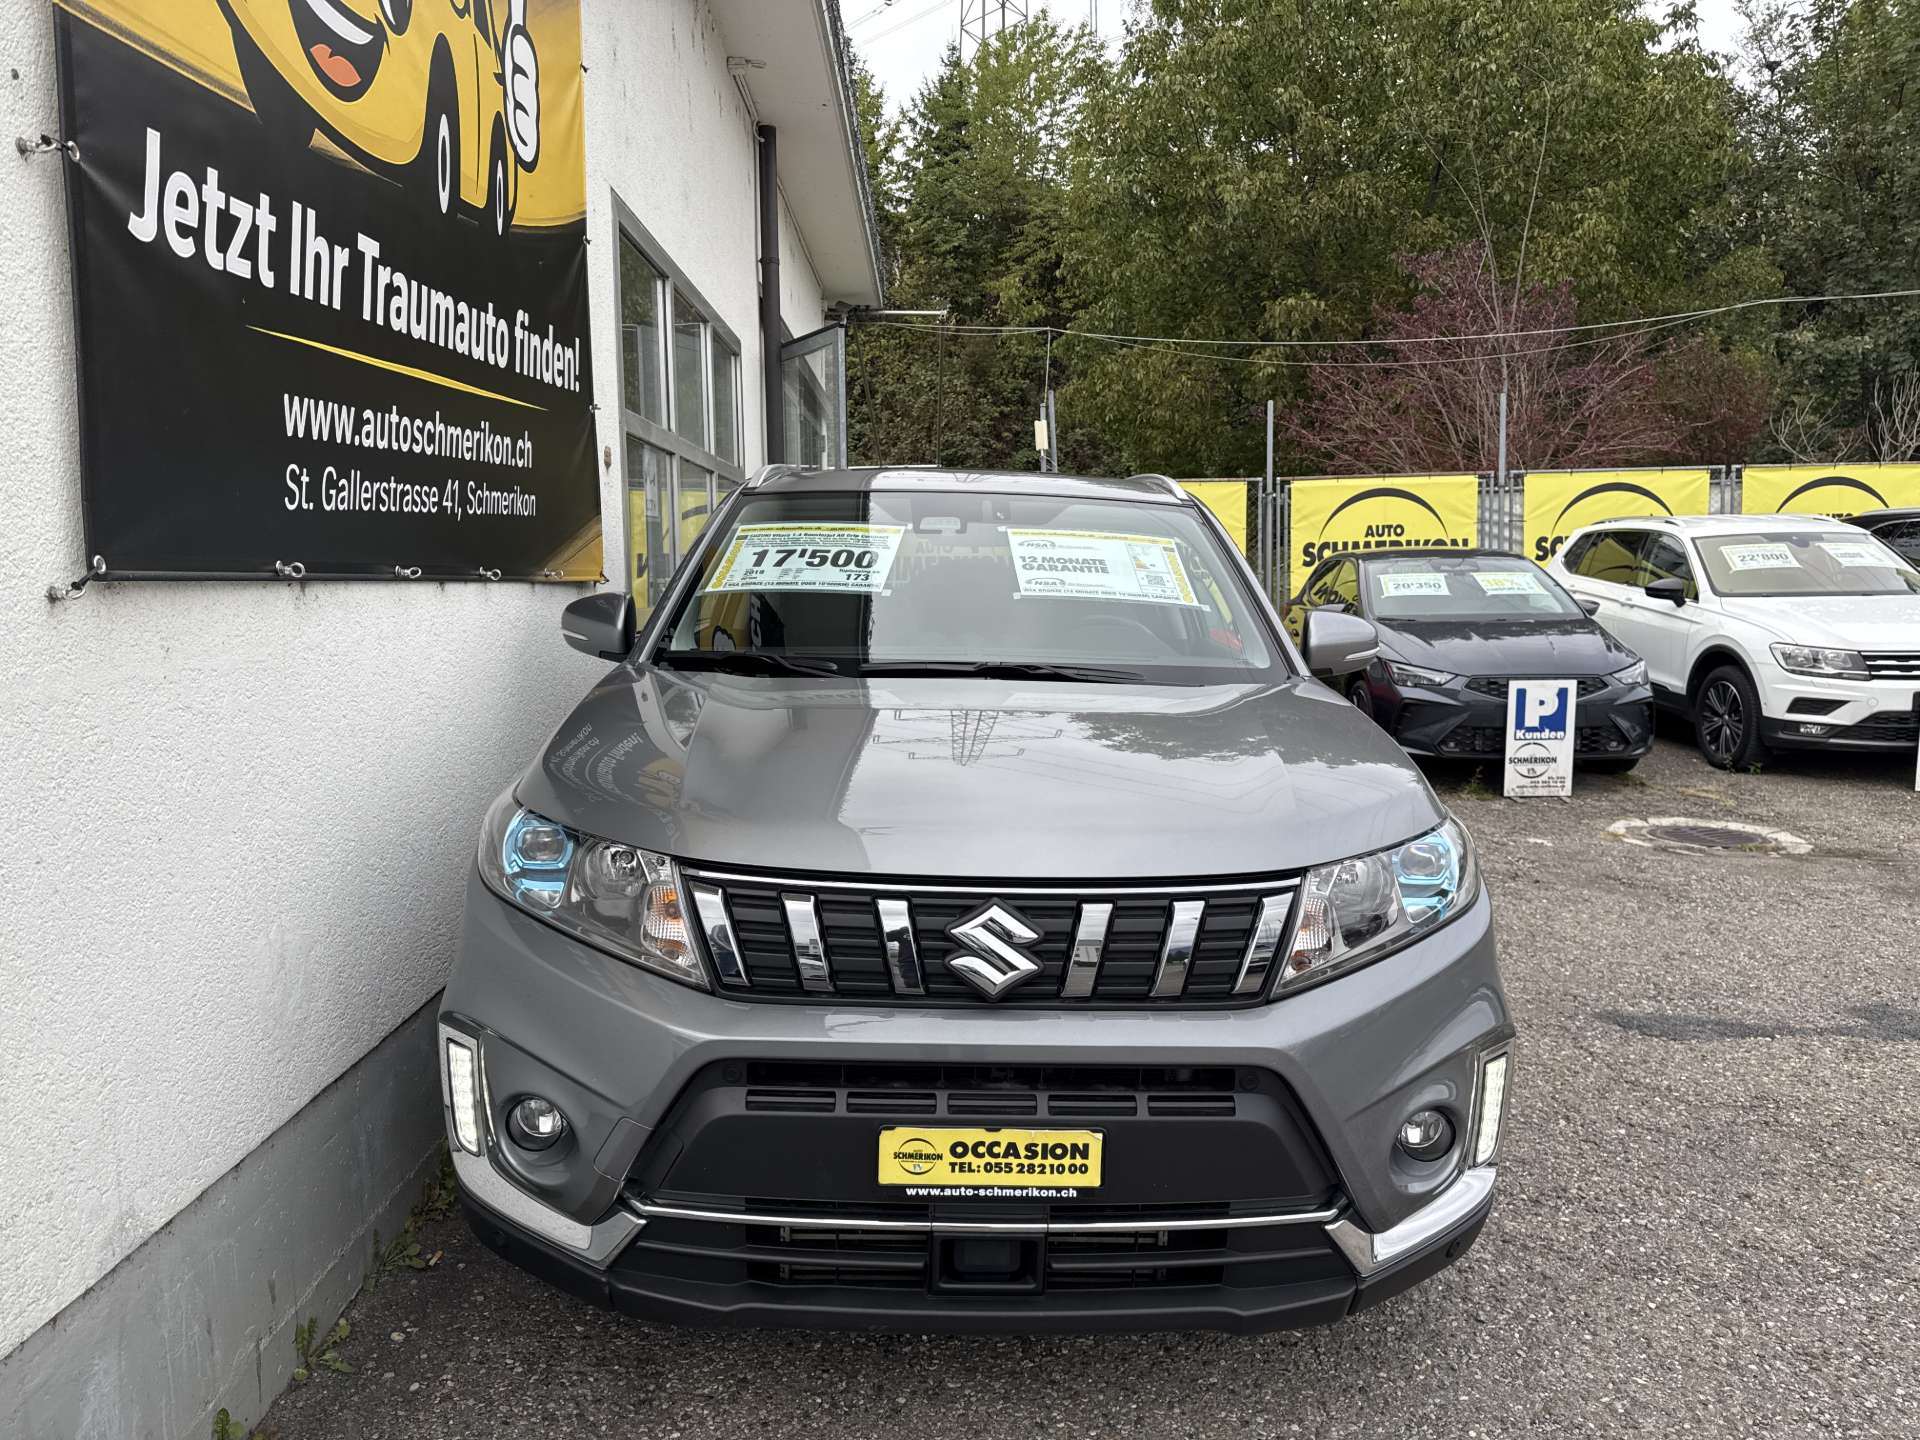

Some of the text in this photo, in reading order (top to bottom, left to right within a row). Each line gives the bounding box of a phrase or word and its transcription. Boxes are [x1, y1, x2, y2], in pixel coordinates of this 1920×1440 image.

[128, 127, 580, 392] Jetzt Ihr Traumauto finden!
[283, 393, 533, 468] www.autoschmerikon.ch
[284, 463, 536, 521] St. Gallerstrasse 41, Schmerikon
[1364, 523, 1405, 537] AUTO
[752, 549, 879, 569] 17'500
[1020, 555, 1107, 567] 12 MONATE
[1021, 563, 1110, 574] GARANTIE
[846, 573, 871, 581] 173
[1515, 728, 1565, 740] Kunden
[1508, 755, 1558, 765] SCHMERIKON
[893, 1151, 944, 1161] SCHMERIKON
[949, 1140, 1090, 1161] OCCASION
[949, 1162, 981, 1174] TEL:
[906, 1187, 1077, 1198] www.auto-schmerikon.ch
